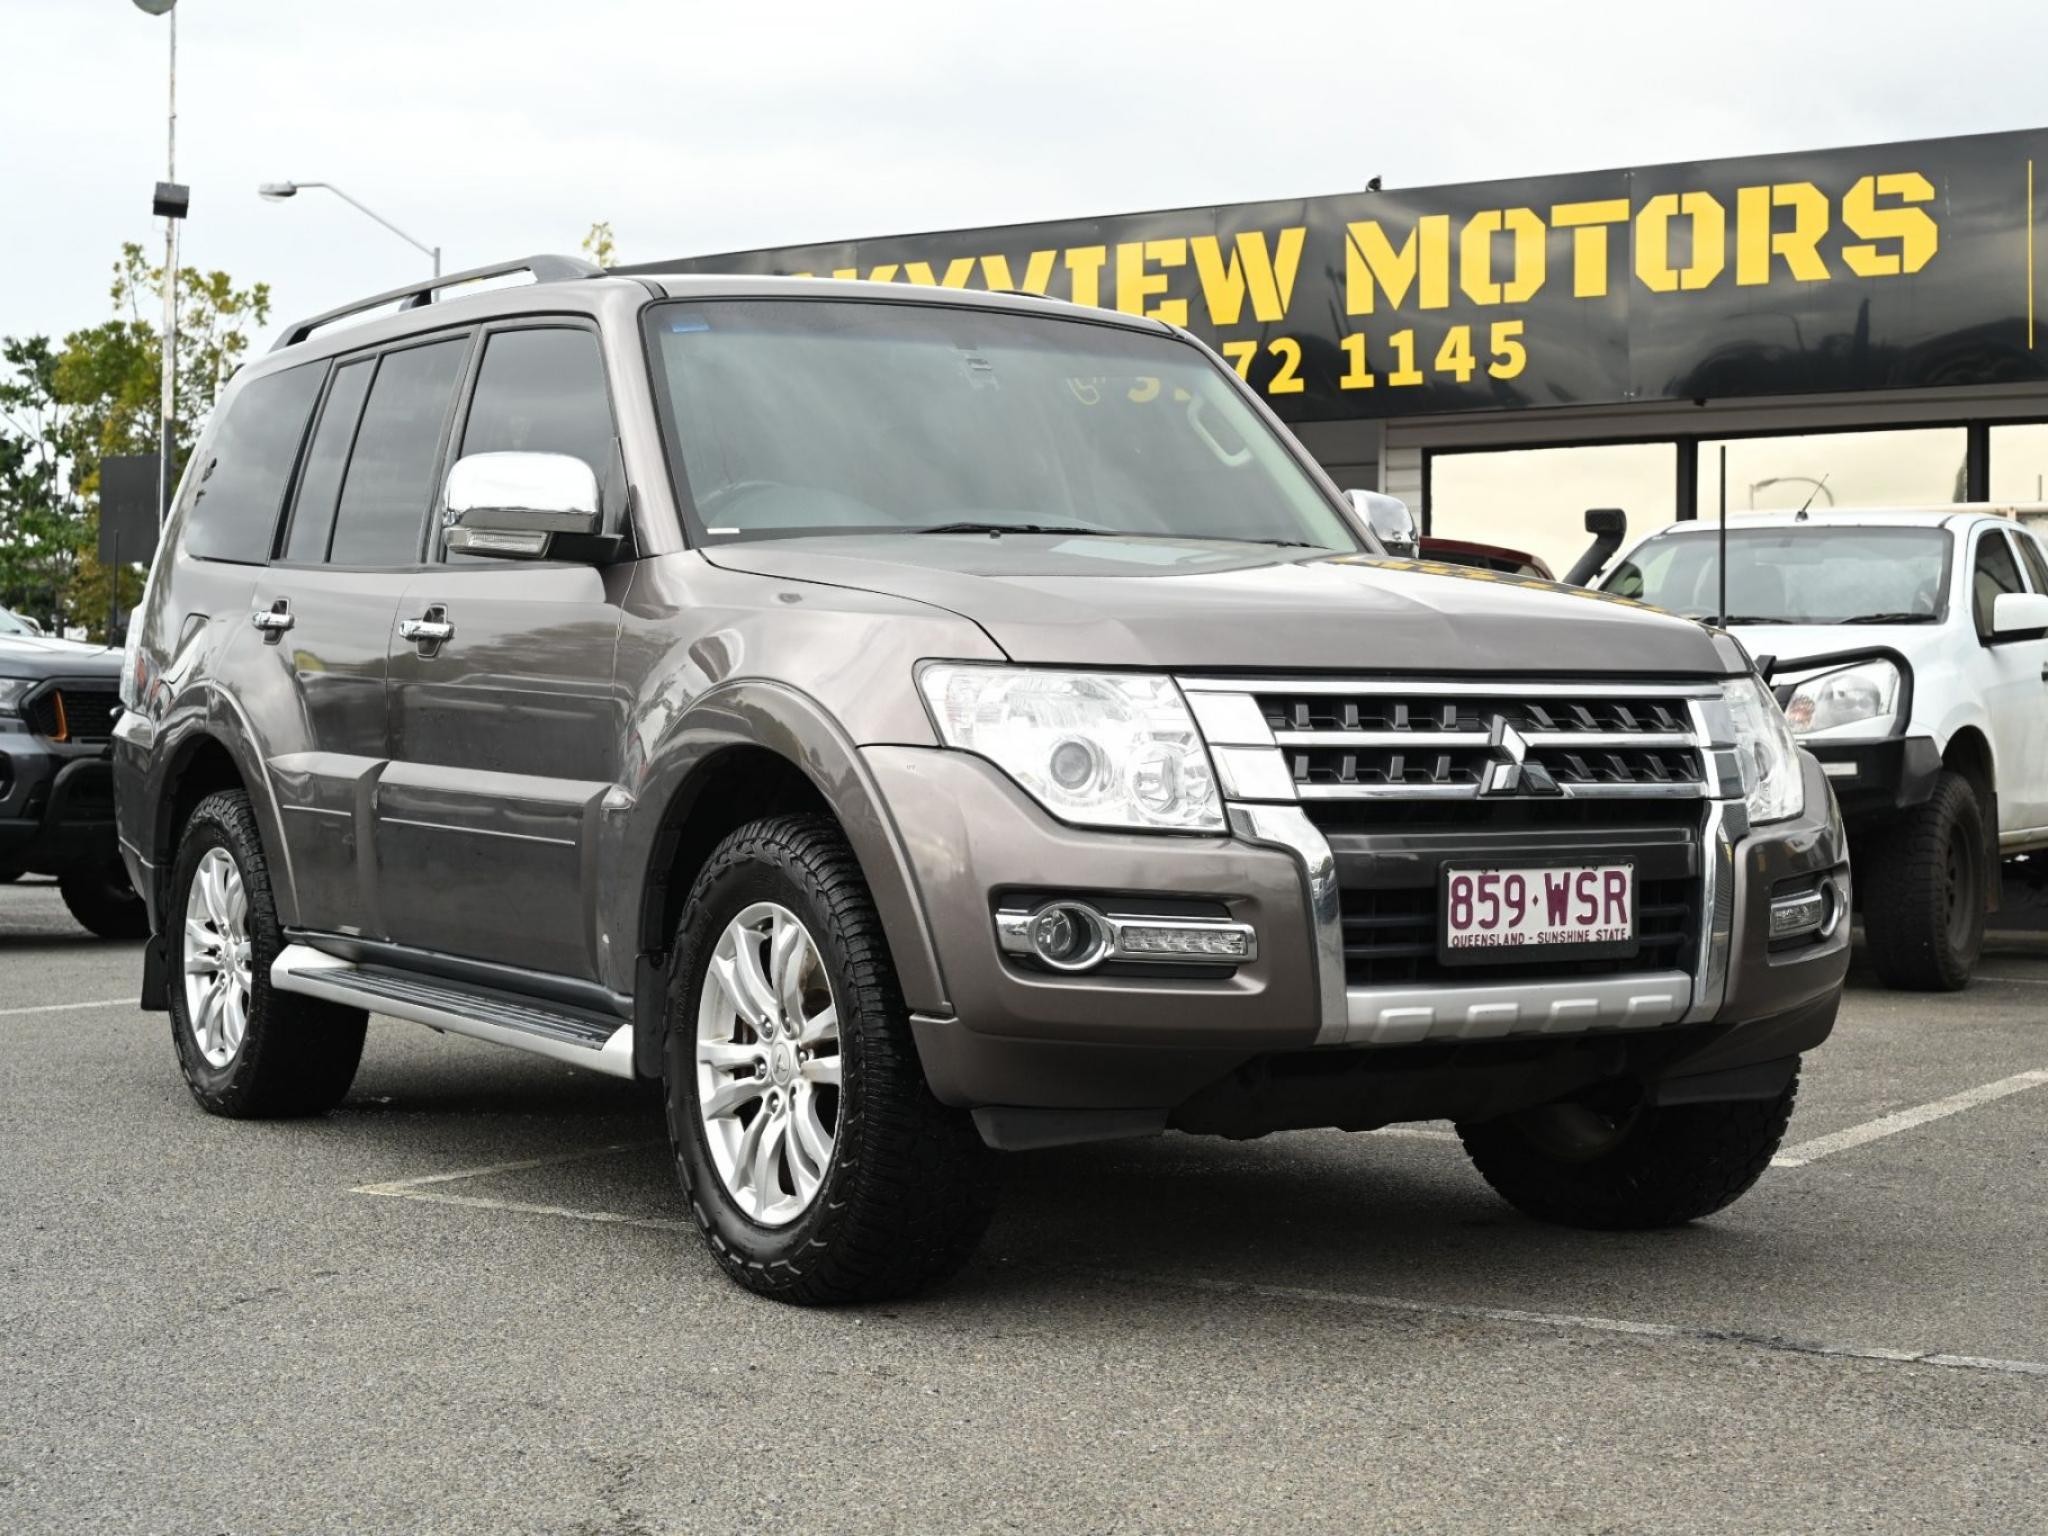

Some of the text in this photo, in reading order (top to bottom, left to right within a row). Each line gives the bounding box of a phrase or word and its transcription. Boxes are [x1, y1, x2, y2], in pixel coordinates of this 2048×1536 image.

[1346, 172, 1938, 315] MOTORS
[1340, 320, 1527, 389] 1145
[1451, 871, 1628, 930] 859 WSR
[1452, 933, 1525, 947] QUEENSLAND
[1537, 930, 1590, 944] SUNSHINE
[1596, 928, 1627, 941] STATE
